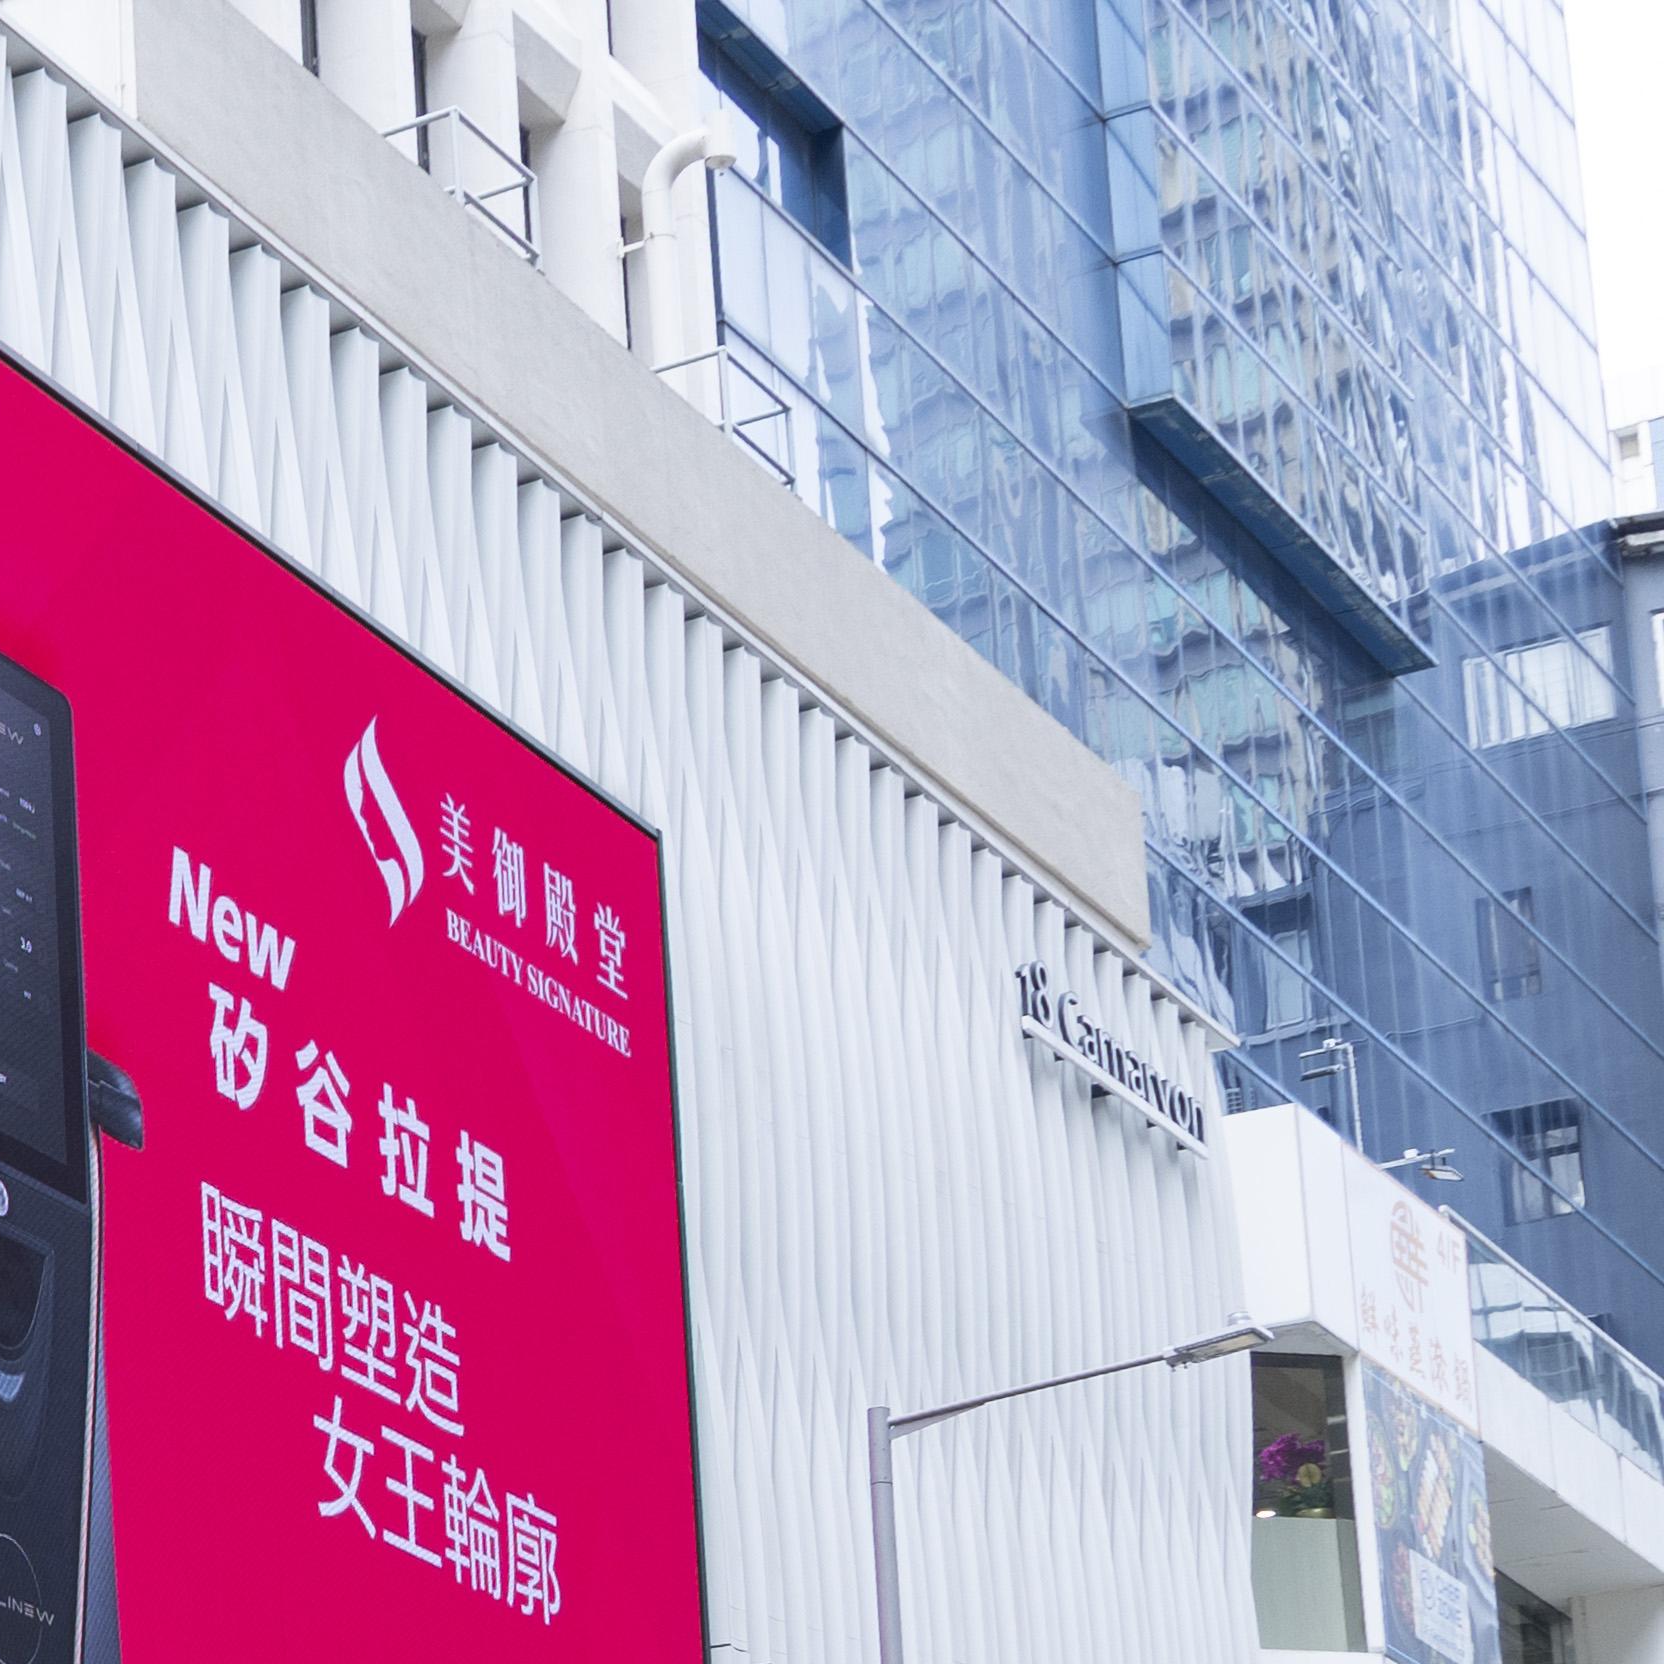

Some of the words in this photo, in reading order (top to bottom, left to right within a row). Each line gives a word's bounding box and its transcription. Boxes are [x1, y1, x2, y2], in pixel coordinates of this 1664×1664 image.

[169, 845, 296, 991] New
[440, 793, 629, 1000] 美御殿堂
[446, 908, 524, 987] BEAUTY
[527, 964, 632, 1058] SIGNATURE
[209, 981, 511, 1263] 矽谷拉提
[1015, 960, 1054, 1029] 18
[1057, 990, 1205, 1145] Carnarvon
[201, 1180, 465, 1437] 瞬間塑造
[313, 1394, 561, 1626] 女王輪廓
